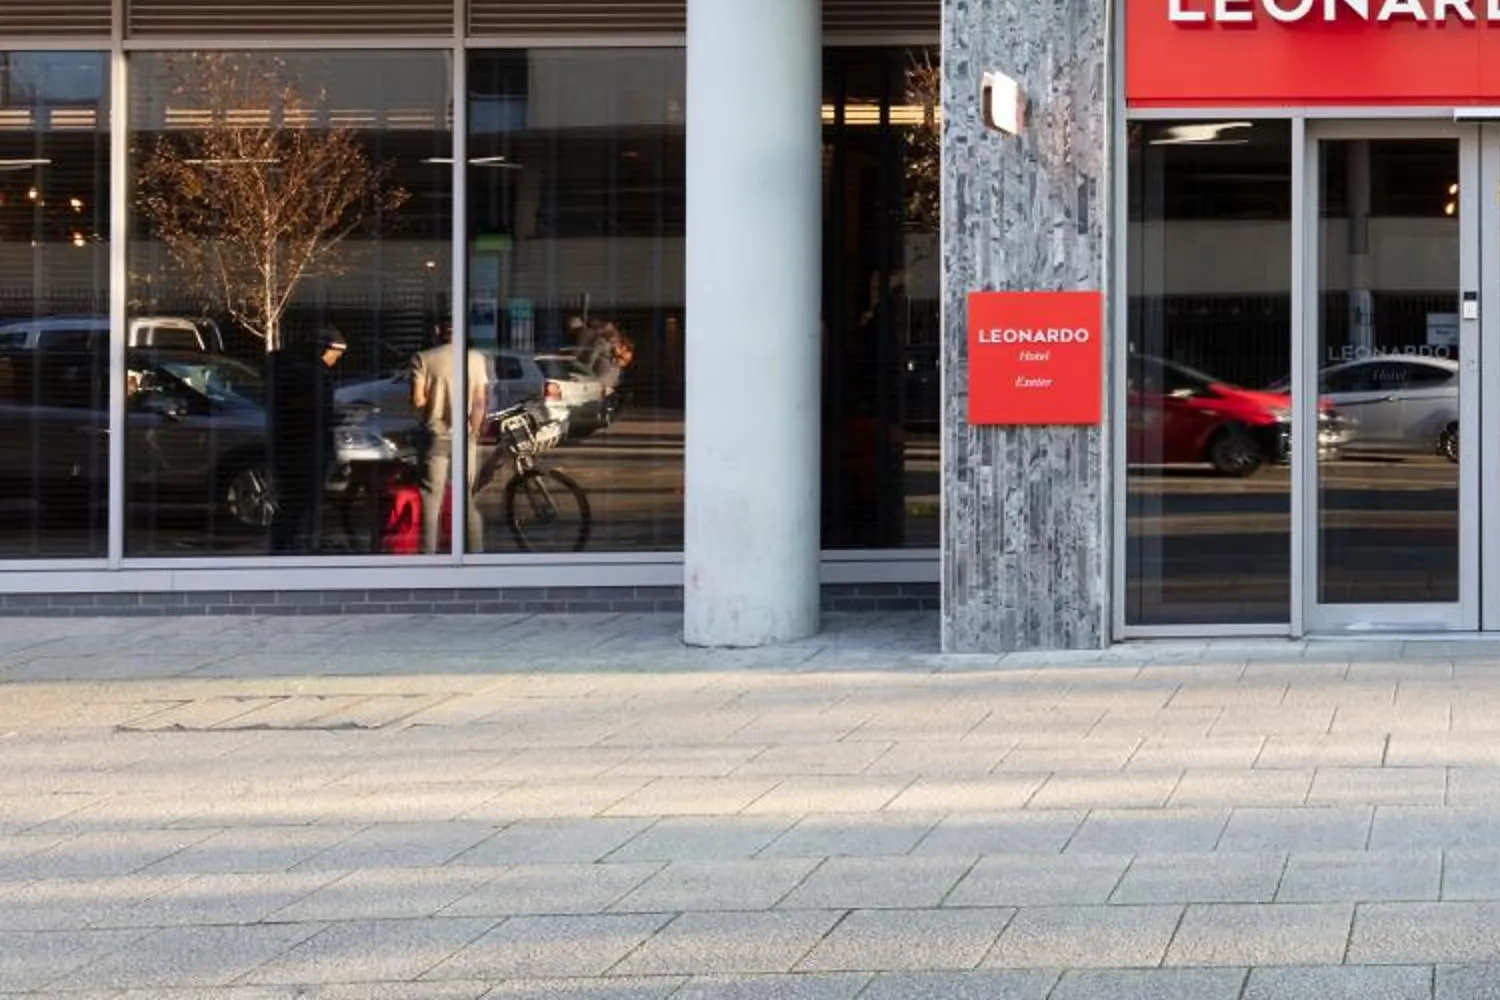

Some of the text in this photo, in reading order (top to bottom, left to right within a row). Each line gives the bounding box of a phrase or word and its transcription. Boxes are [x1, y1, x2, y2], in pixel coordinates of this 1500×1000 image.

[978, 328, 1089, 343] LEONARDO
[1018, 350, 1051, 361] Hotel
[1328, 345, 1451, 360] LEONARDO
